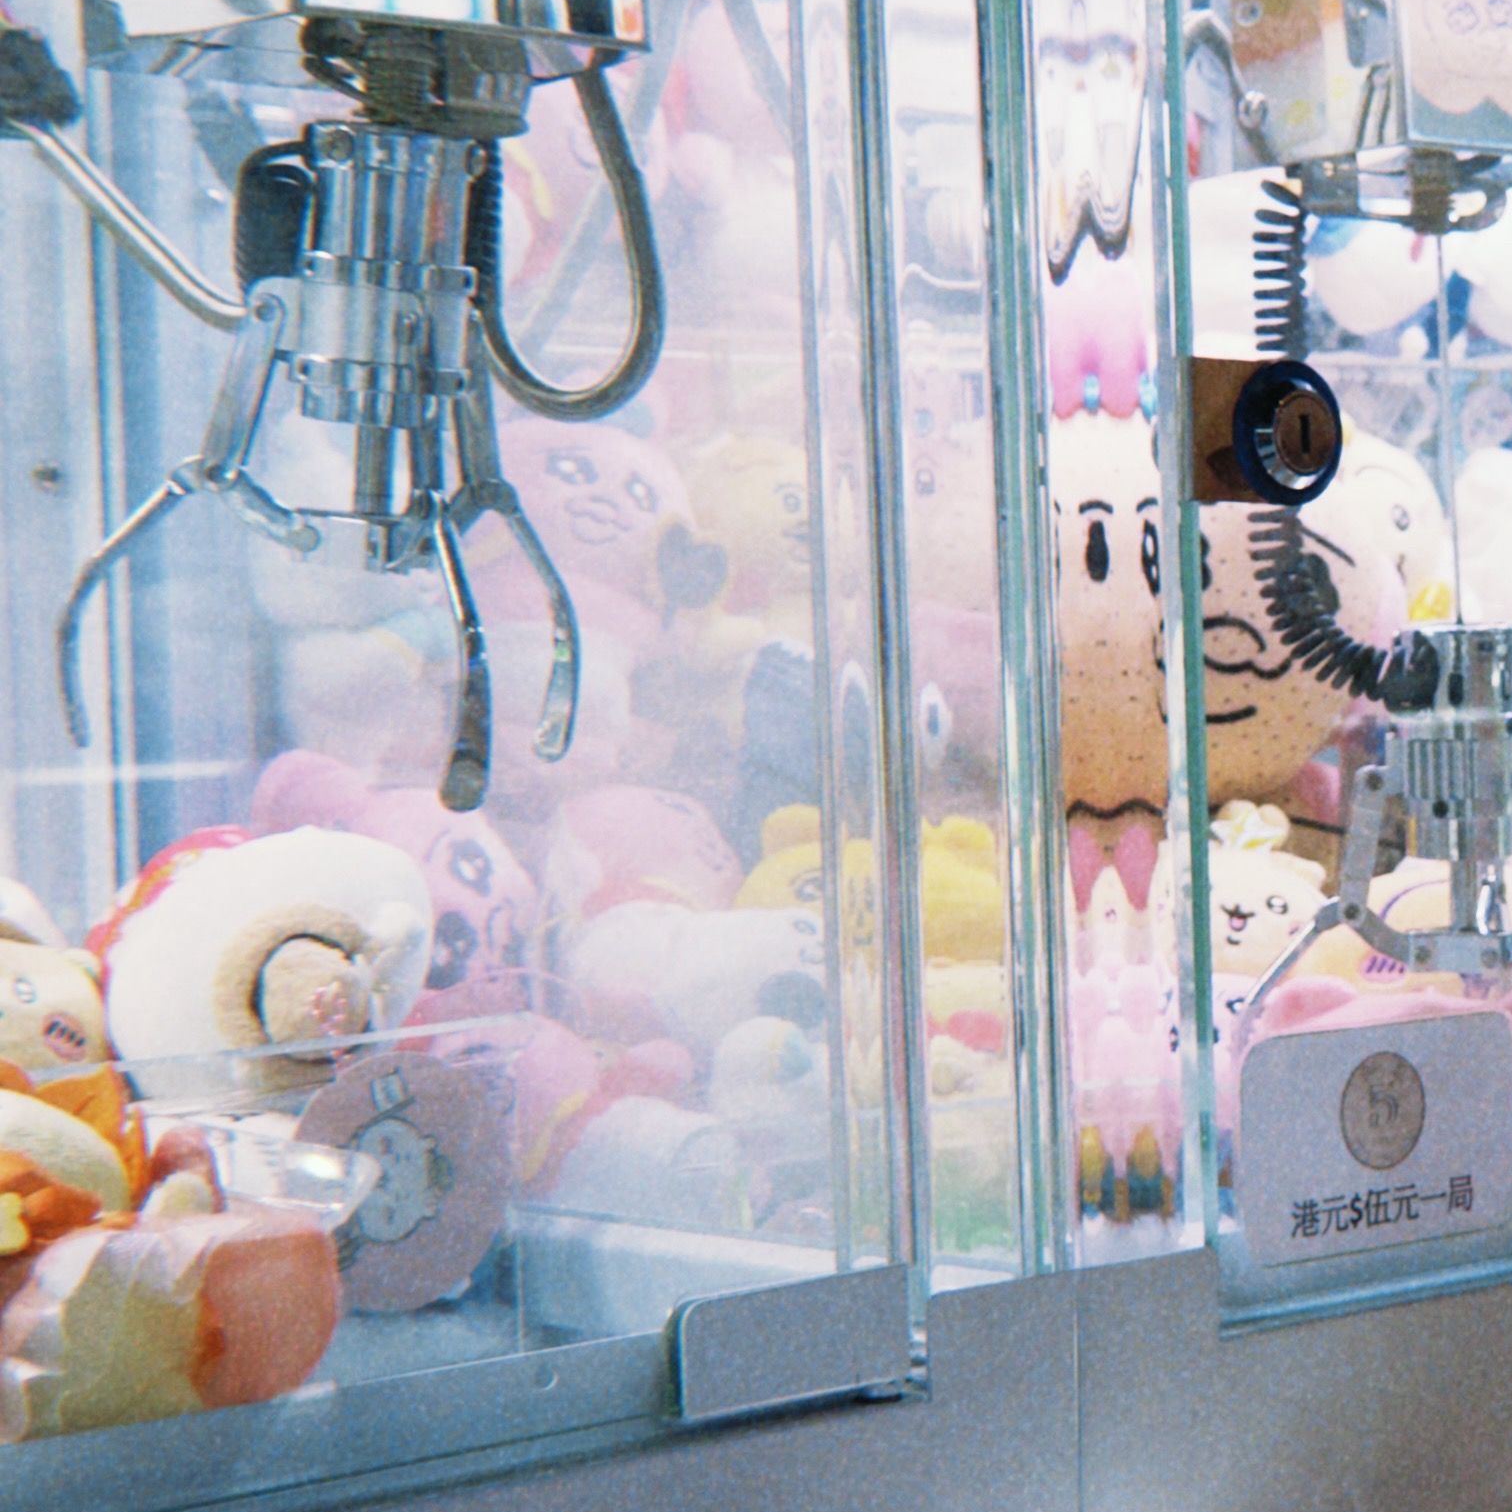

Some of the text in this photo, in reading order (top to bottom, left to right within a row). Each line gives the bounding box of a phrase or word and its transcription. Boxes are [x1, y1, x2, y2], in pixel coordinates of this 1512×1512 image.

[1291, 1174, 1474, 1238] 港元$伍元一局
